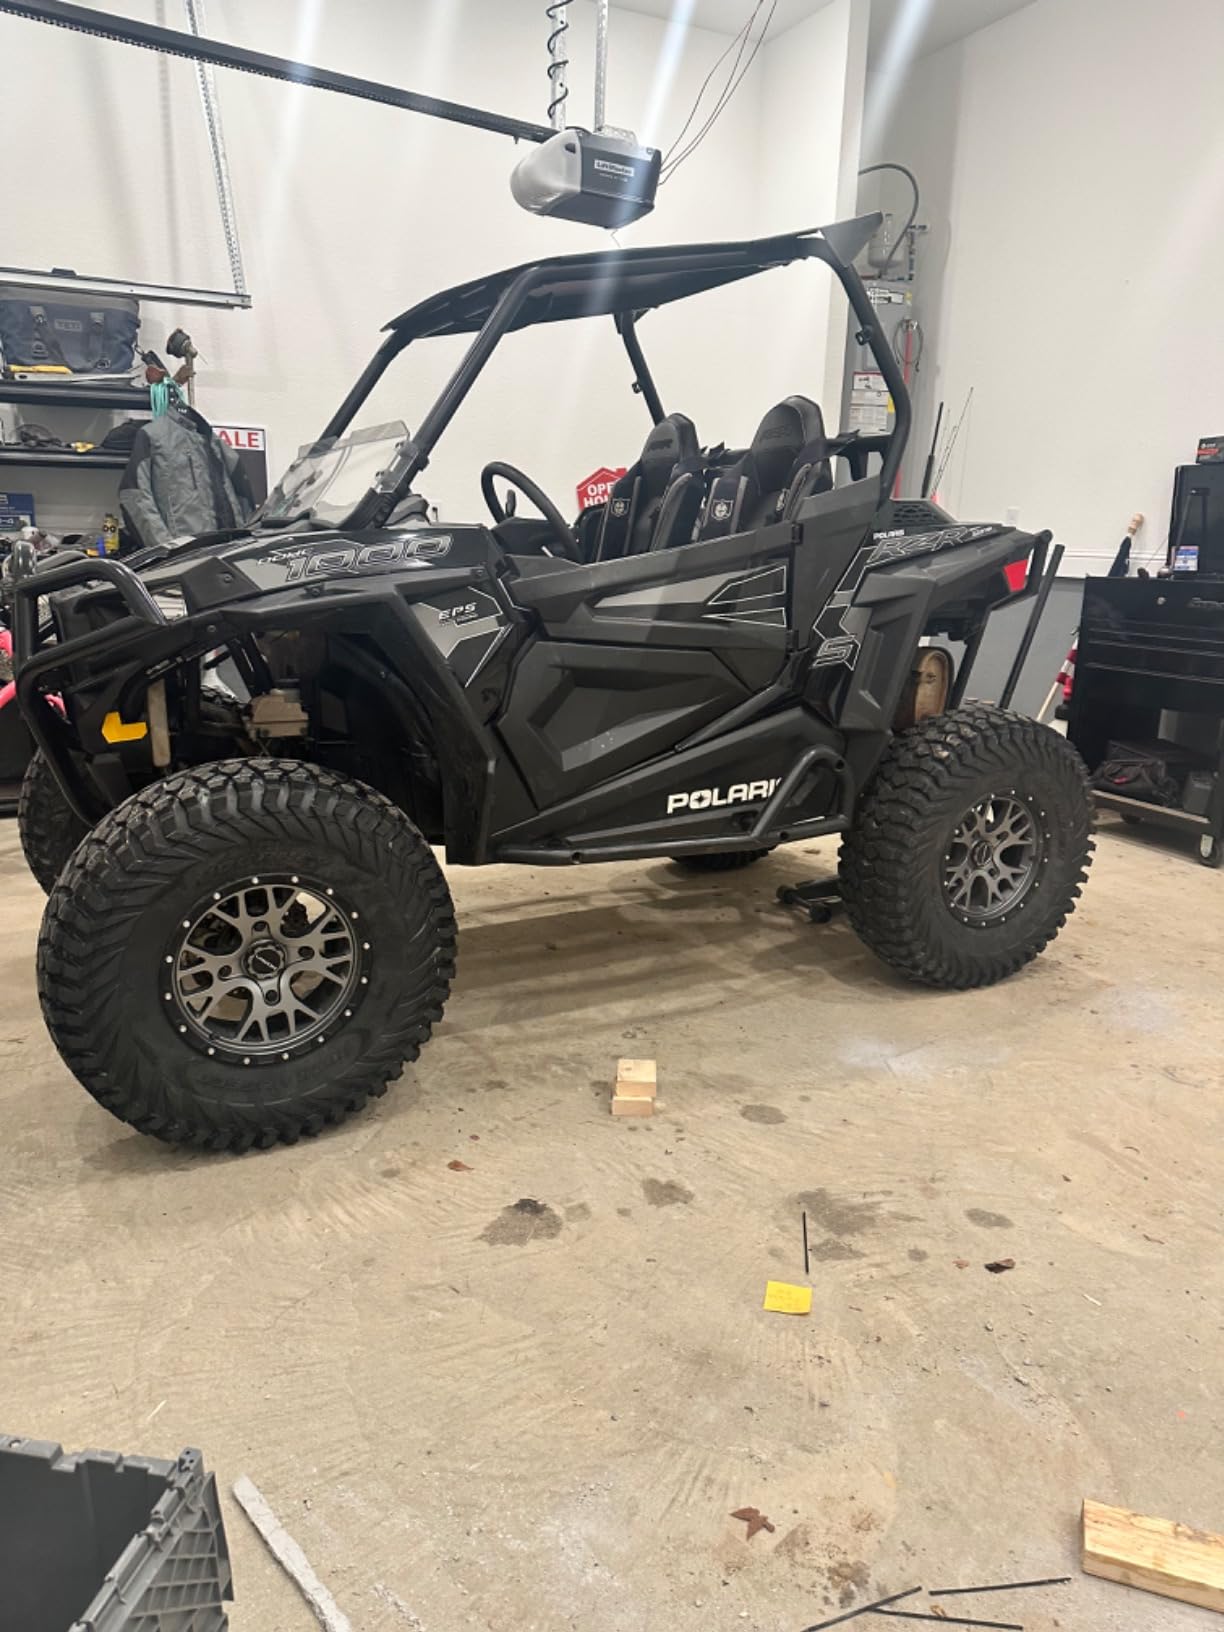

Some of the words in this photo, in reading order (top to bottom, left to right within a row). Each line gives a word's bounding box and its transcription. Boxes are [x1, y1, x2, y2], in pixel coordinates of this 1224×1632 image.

[218, 430, 260, 448] ALE
[286, 533, 454, 582] 1000
[666, 777, 782, 814] POLARI
